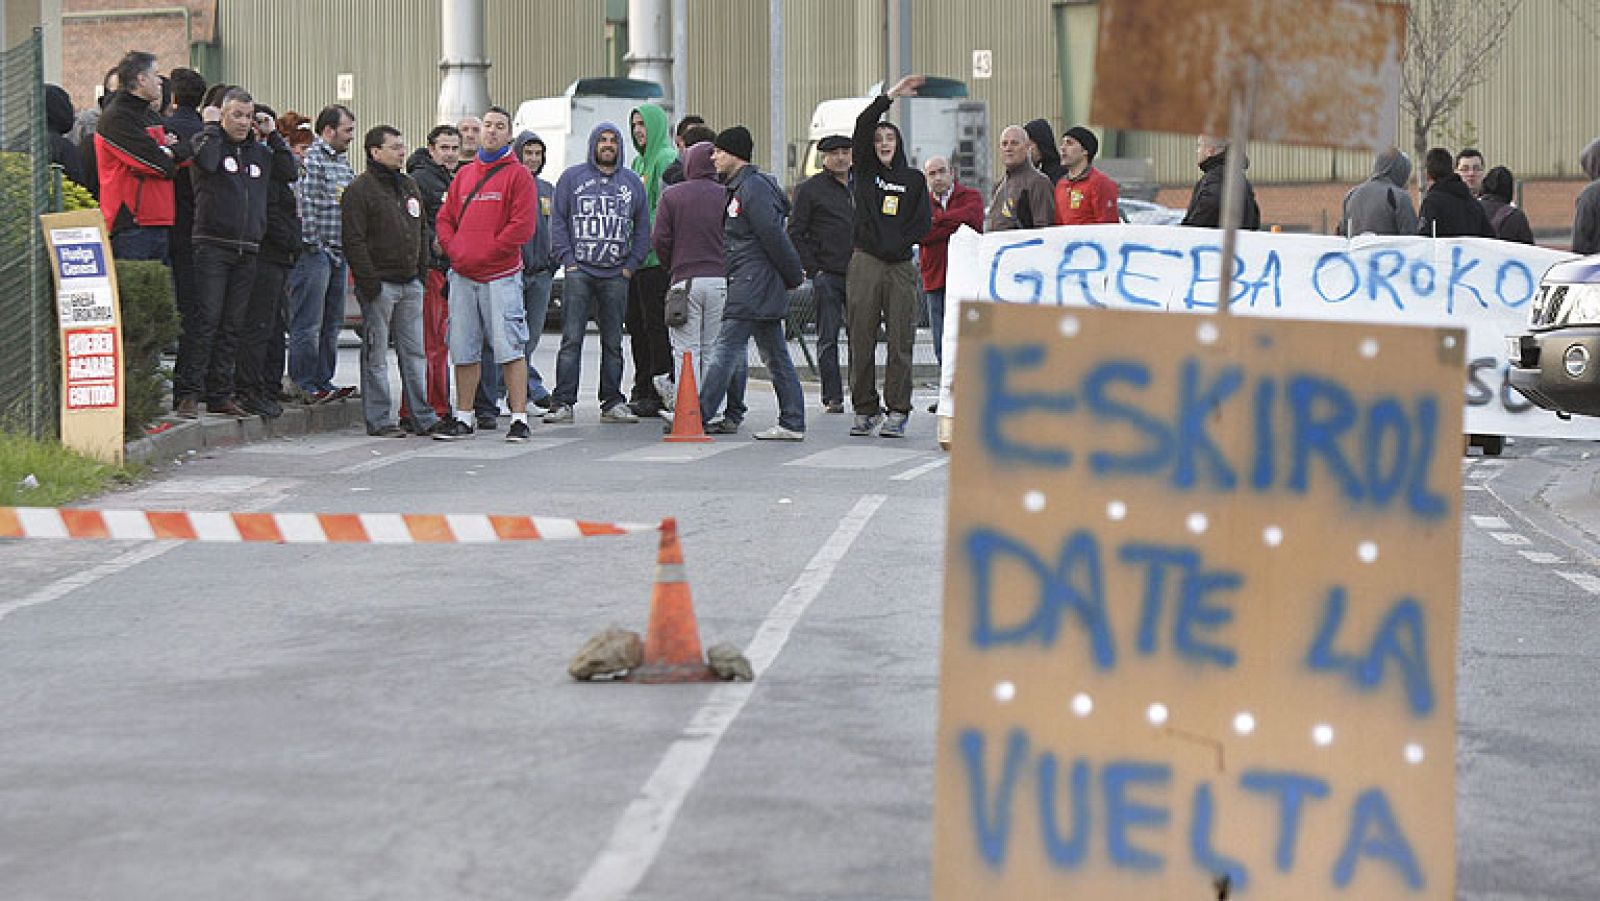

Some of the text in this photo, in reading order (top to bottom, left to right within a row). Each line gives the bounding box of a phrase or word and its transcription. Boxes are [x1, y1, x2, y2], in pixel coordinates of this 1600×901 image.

[976, 52, 990, 74] 43
[59, 247, 95, 263] Huelga
[988, 238, 1282, 311] GREBA
[979, 334, 1449, 521] ESKIROL
[963, 527, 1435, 717] DATE LA
[957, 726, 1427, 893] VUELTA
